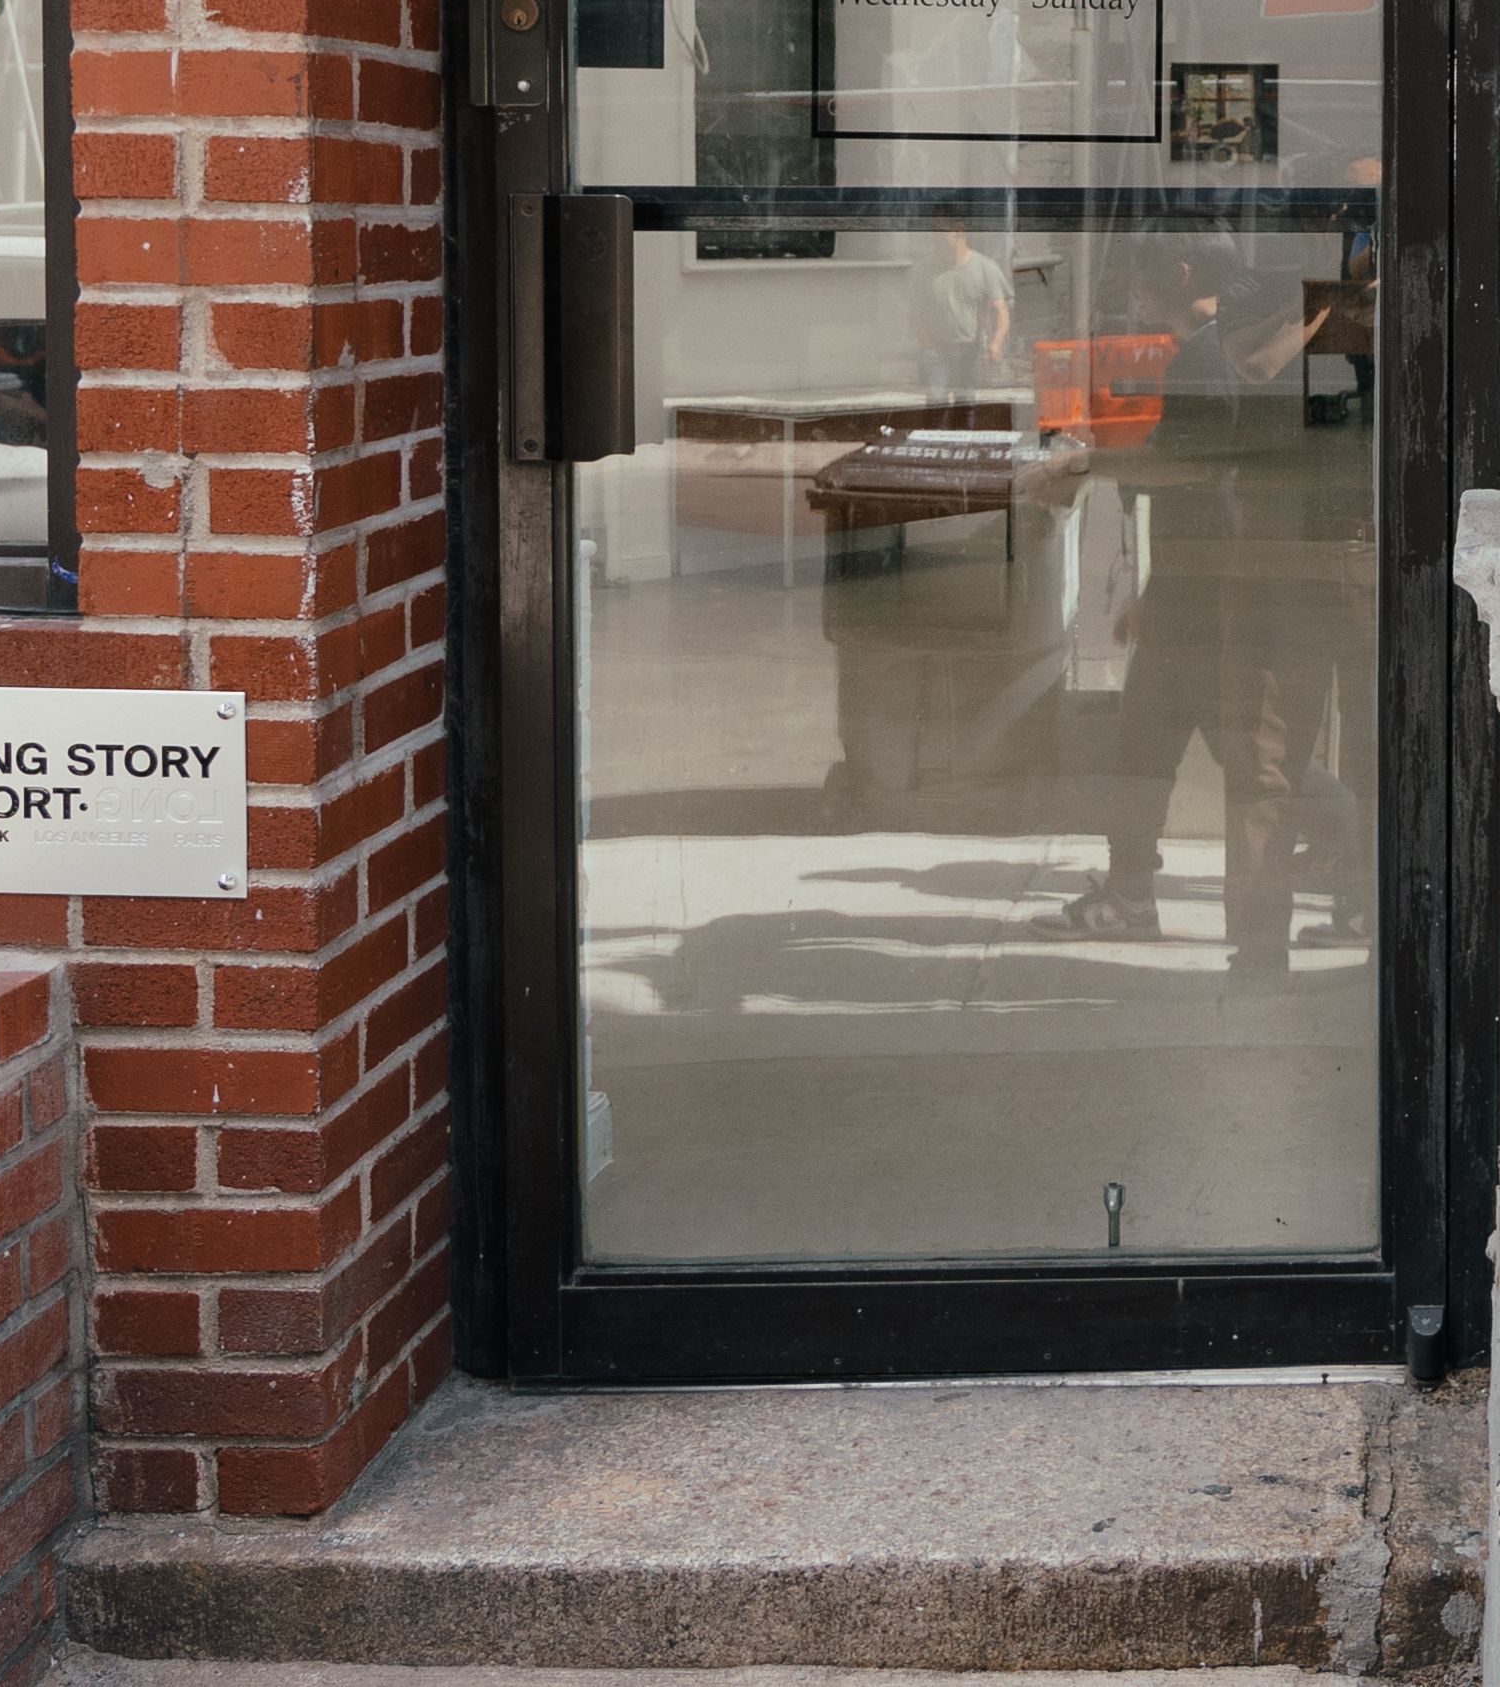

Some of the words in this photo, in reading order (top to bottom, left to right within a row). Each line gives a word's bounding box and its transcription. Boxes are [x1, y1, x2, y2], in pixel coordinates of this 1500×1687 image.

[66, 742, 221, 779] STORY
[33, 830, 69, 845] LOS
[69, 831, 151, 847] ANGELES
[173, 832, 224, 848] PARIS
